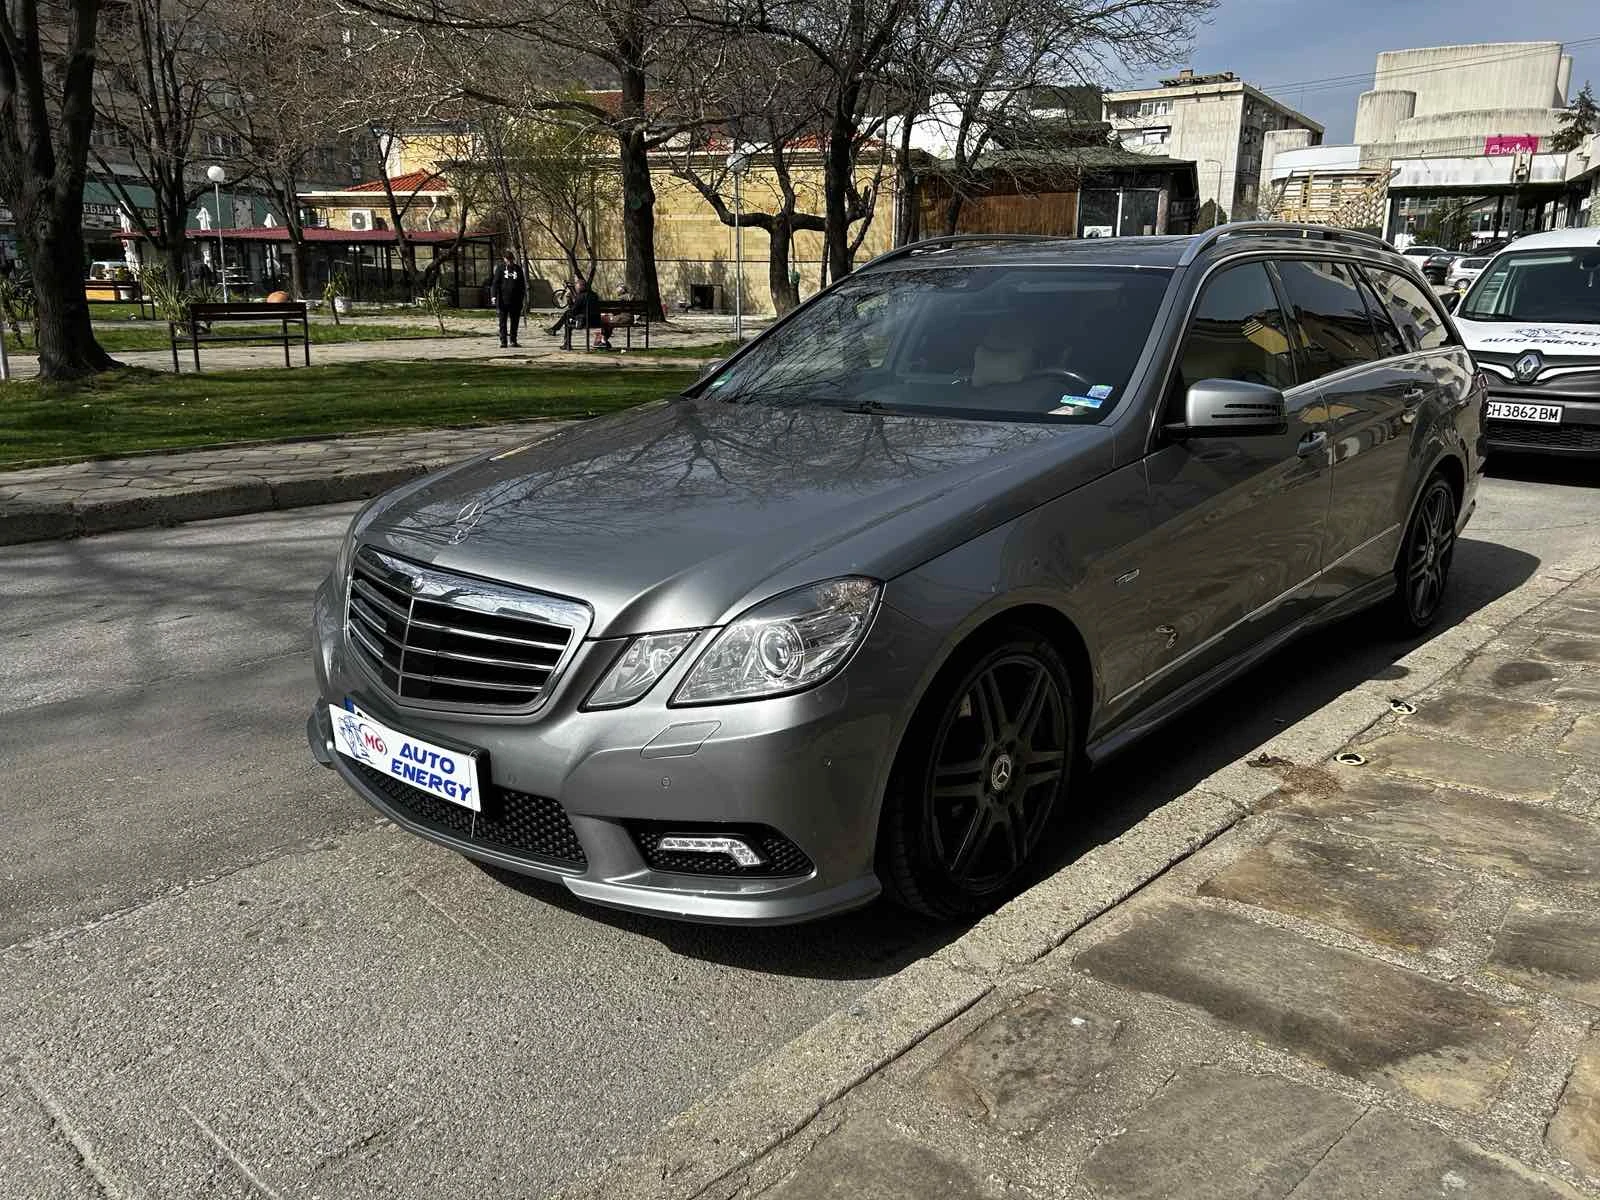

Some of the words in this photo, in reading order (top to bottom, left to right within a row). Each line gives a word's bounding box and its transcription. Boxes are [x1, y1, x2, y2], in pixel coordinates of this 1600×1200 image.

[364, 732, 384, 753] MG
[400, 742, 456, 775] AUTO
[391, 757, 471, 802] ENERGY
